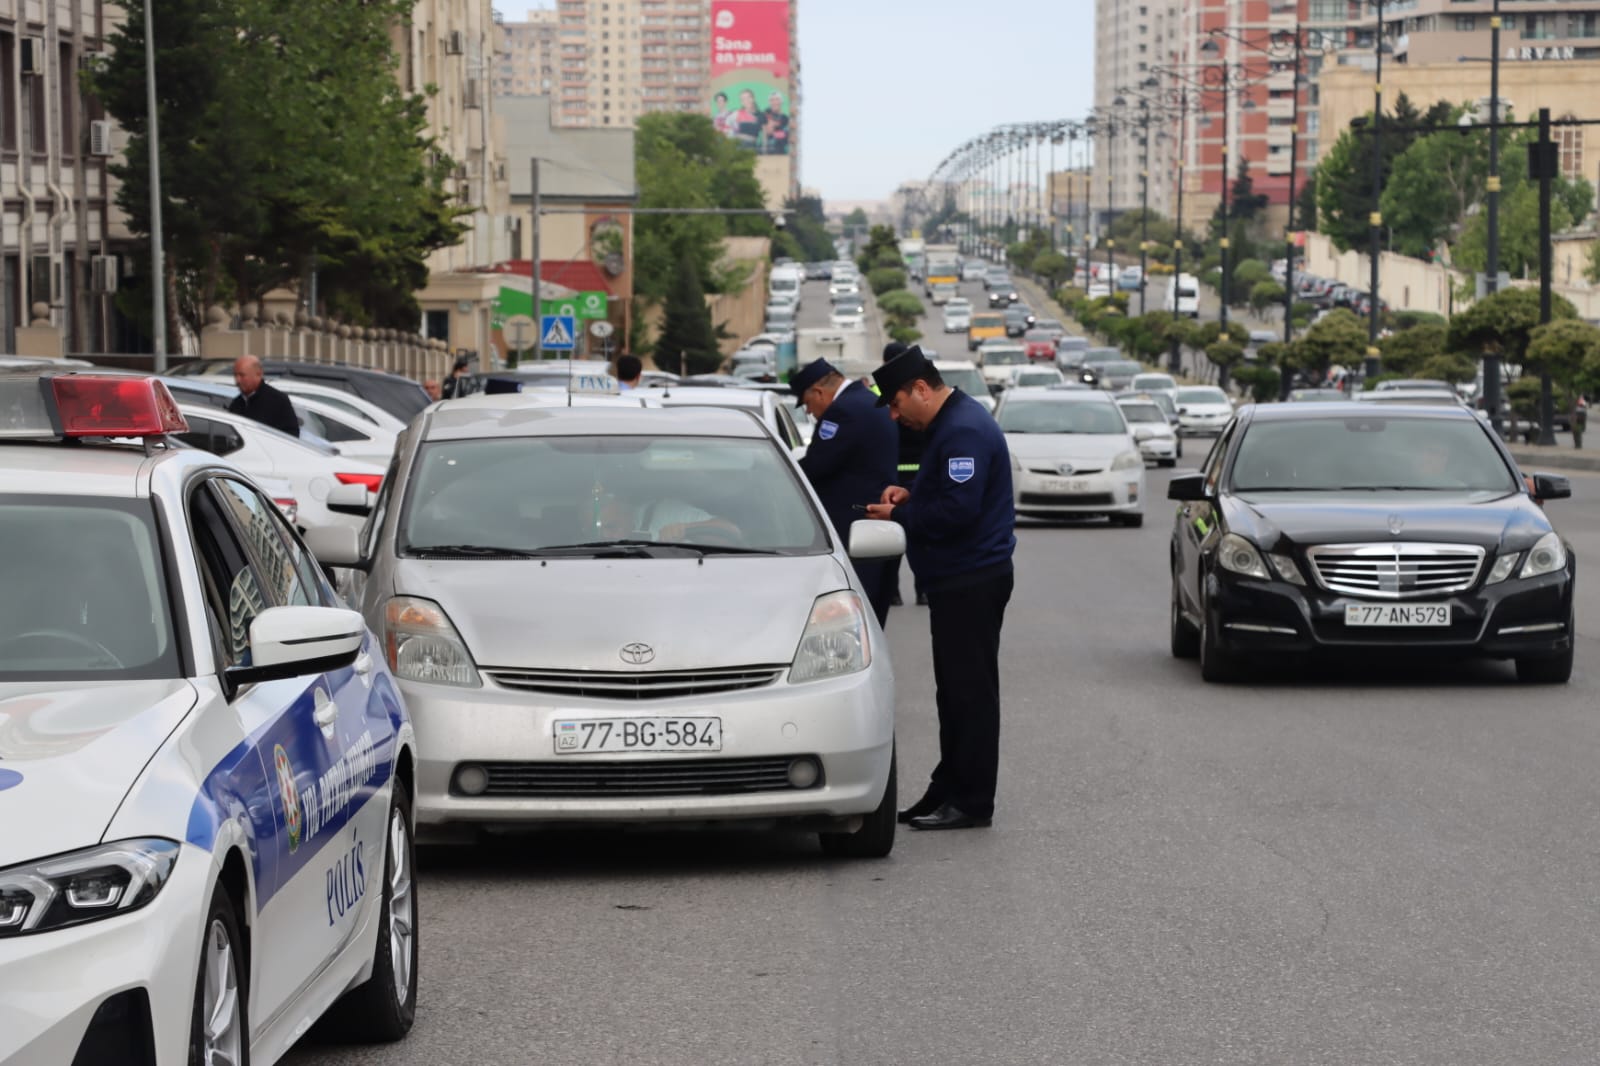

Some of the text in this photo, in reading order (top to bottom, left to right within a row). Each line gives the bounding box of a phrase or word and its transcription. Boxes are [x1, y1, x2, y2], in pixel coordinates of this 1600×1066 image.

[1362, 606, 1447, 623] 77-AN-579
[561, 736, 575, 746] AZ
[581, 721, 714, 749] 77-BG-584
[326, 827, 365, 926] POLİS
